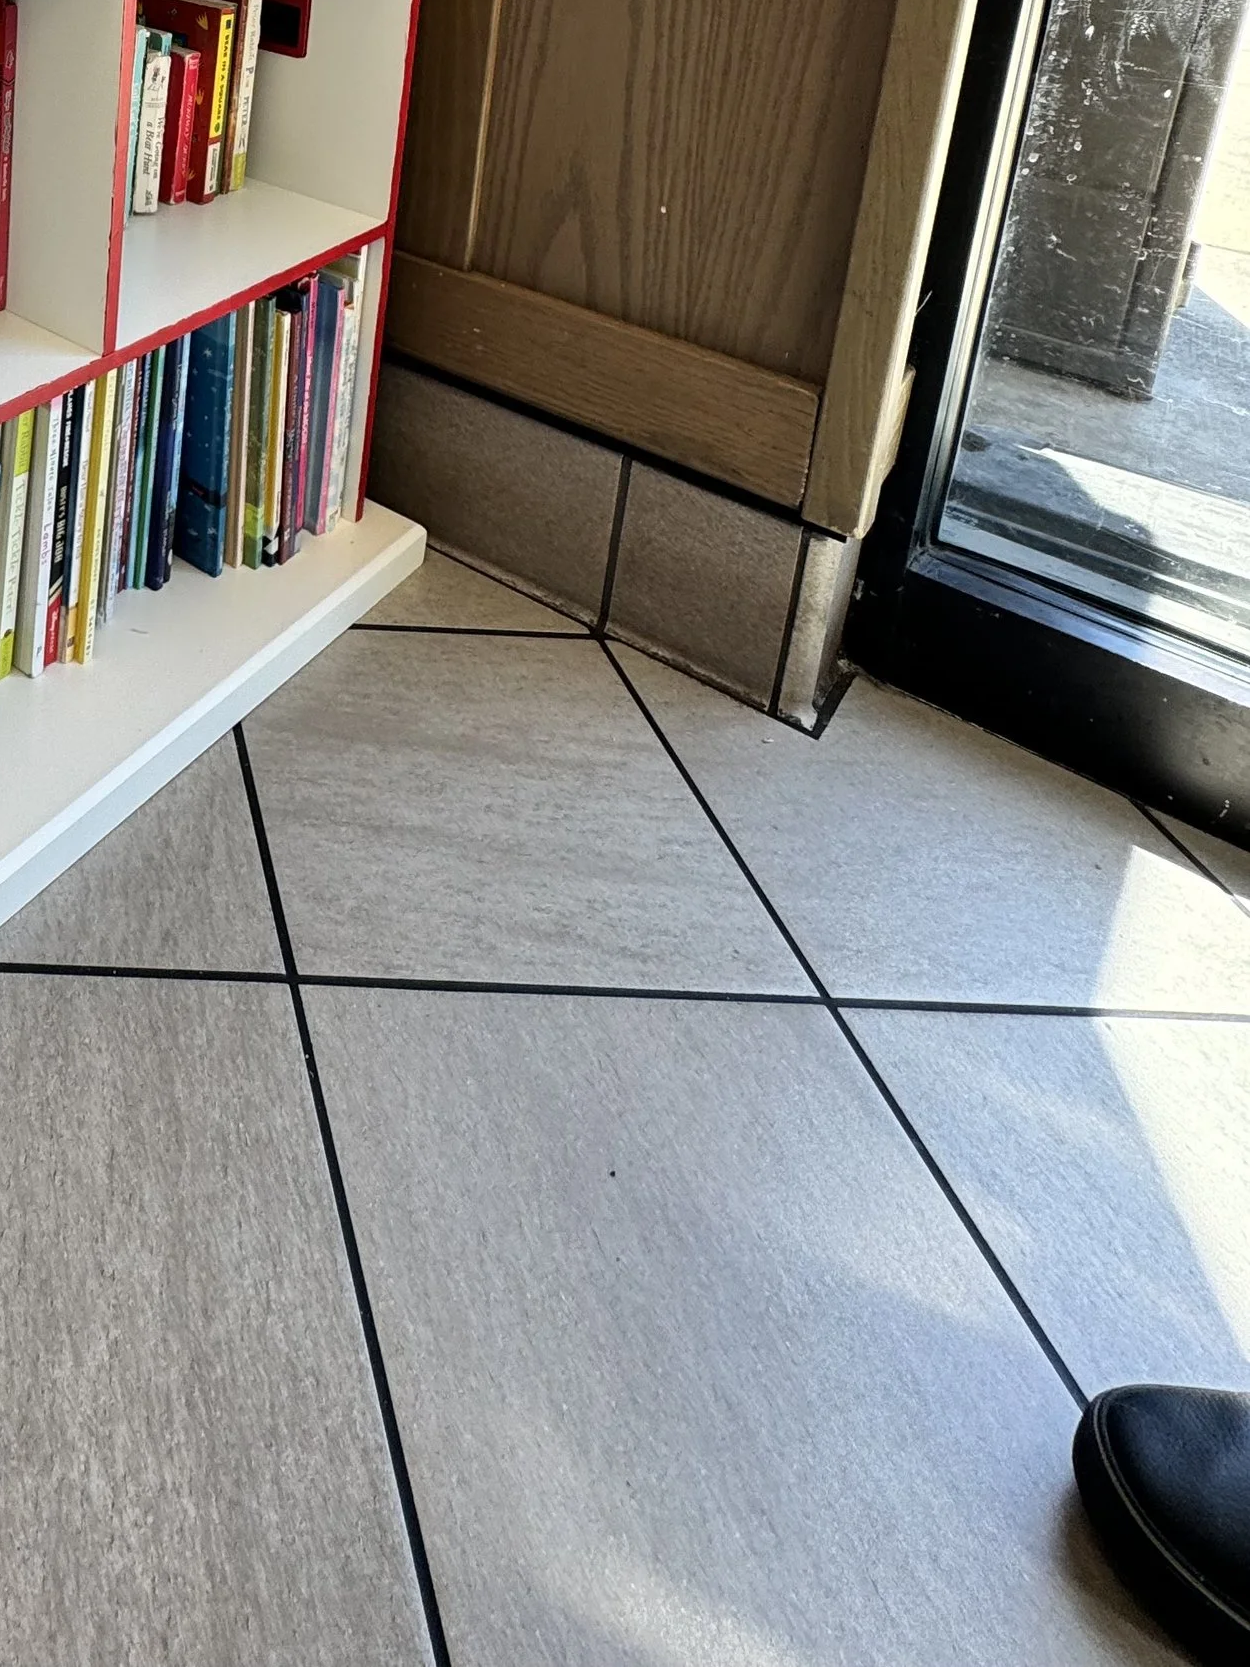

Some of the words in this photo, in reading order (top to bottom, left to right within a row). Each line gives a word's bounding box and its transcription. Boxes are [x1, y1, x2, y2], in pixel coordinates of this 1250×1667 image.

[221, 61, 226, 71] IN
[216, 85, 224, 120] SQUARE
[144, 130, 153, 149] Bear
[142, 152, 151, 174] Hunt
[152, 141, 161, 166] Going
[55, 519, 65, 539] BIG
[40, 522, 50, 565] Lambs
[53, 541, 63, 564] JOB
